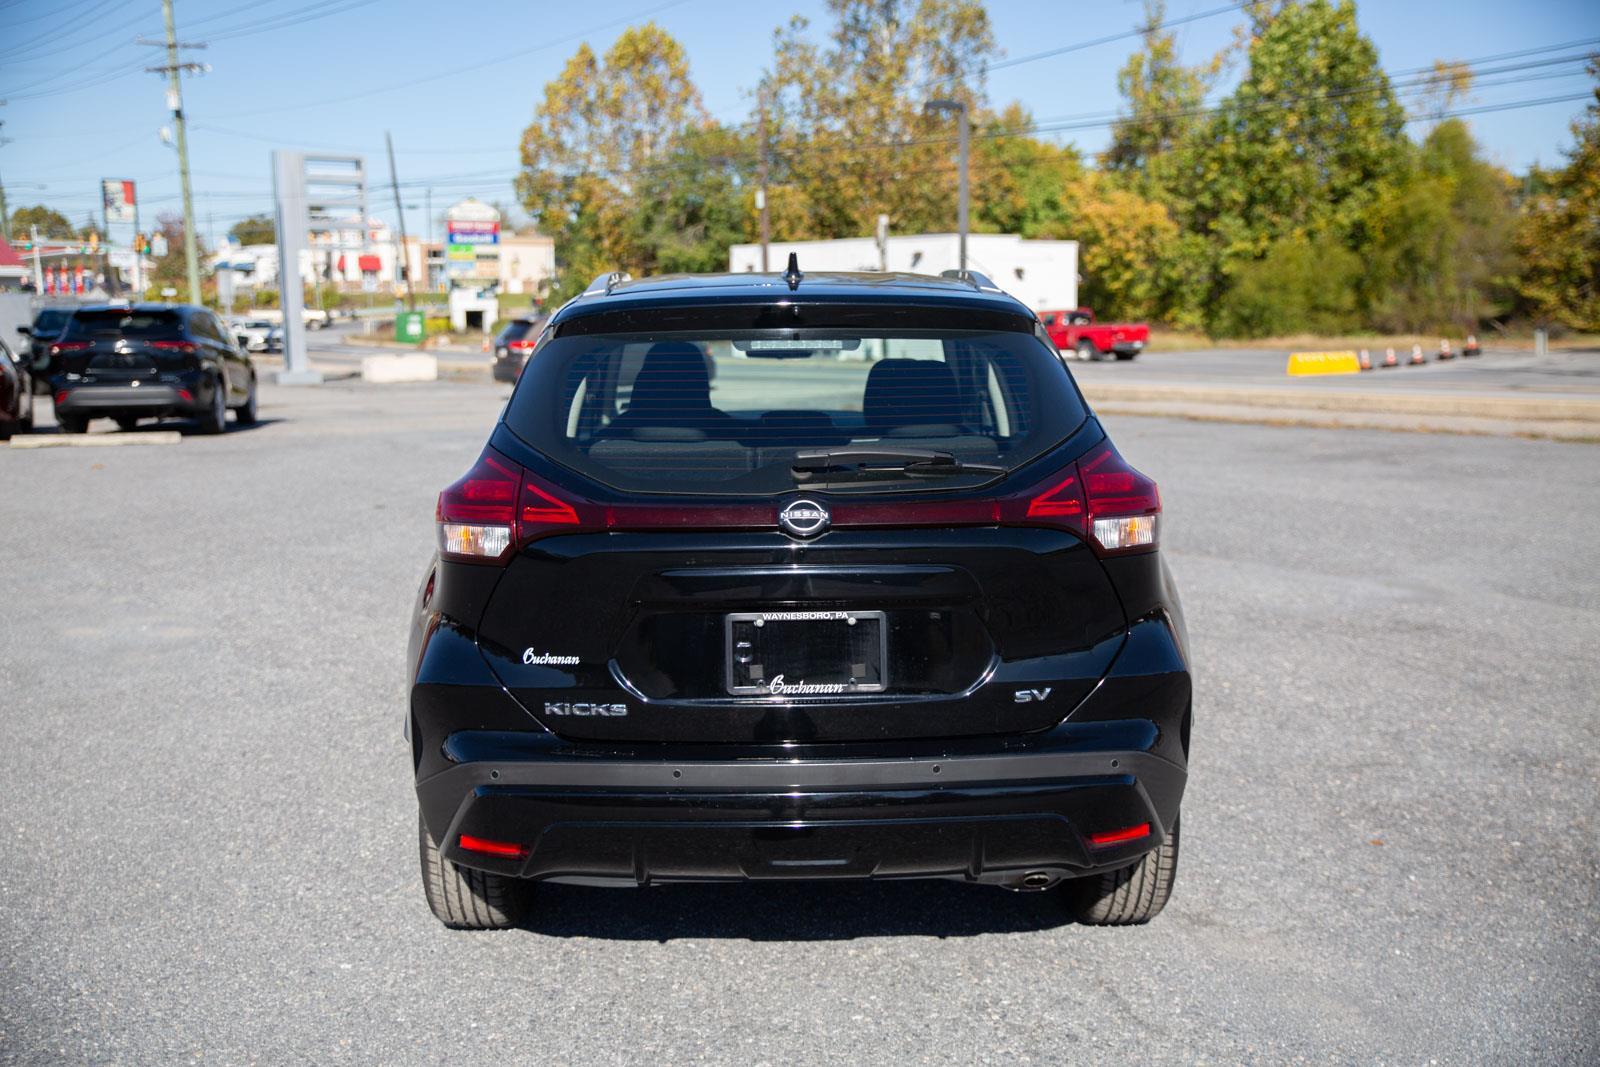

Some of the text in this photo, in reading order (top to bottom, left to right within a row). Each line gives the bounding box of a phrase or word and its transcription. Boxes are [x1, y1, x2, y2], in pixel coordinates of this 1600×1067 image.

[780, 511, 829, 519] NISSAN
[762, 611, 849, 620] WAYNESBORO, PA
[523, 647, 580, 664] Buchanan
[770, 674, 844, 694] Buchanan
[1014, 687, 1052, 703] SV
[544, 702, 628, 716] KICKS
